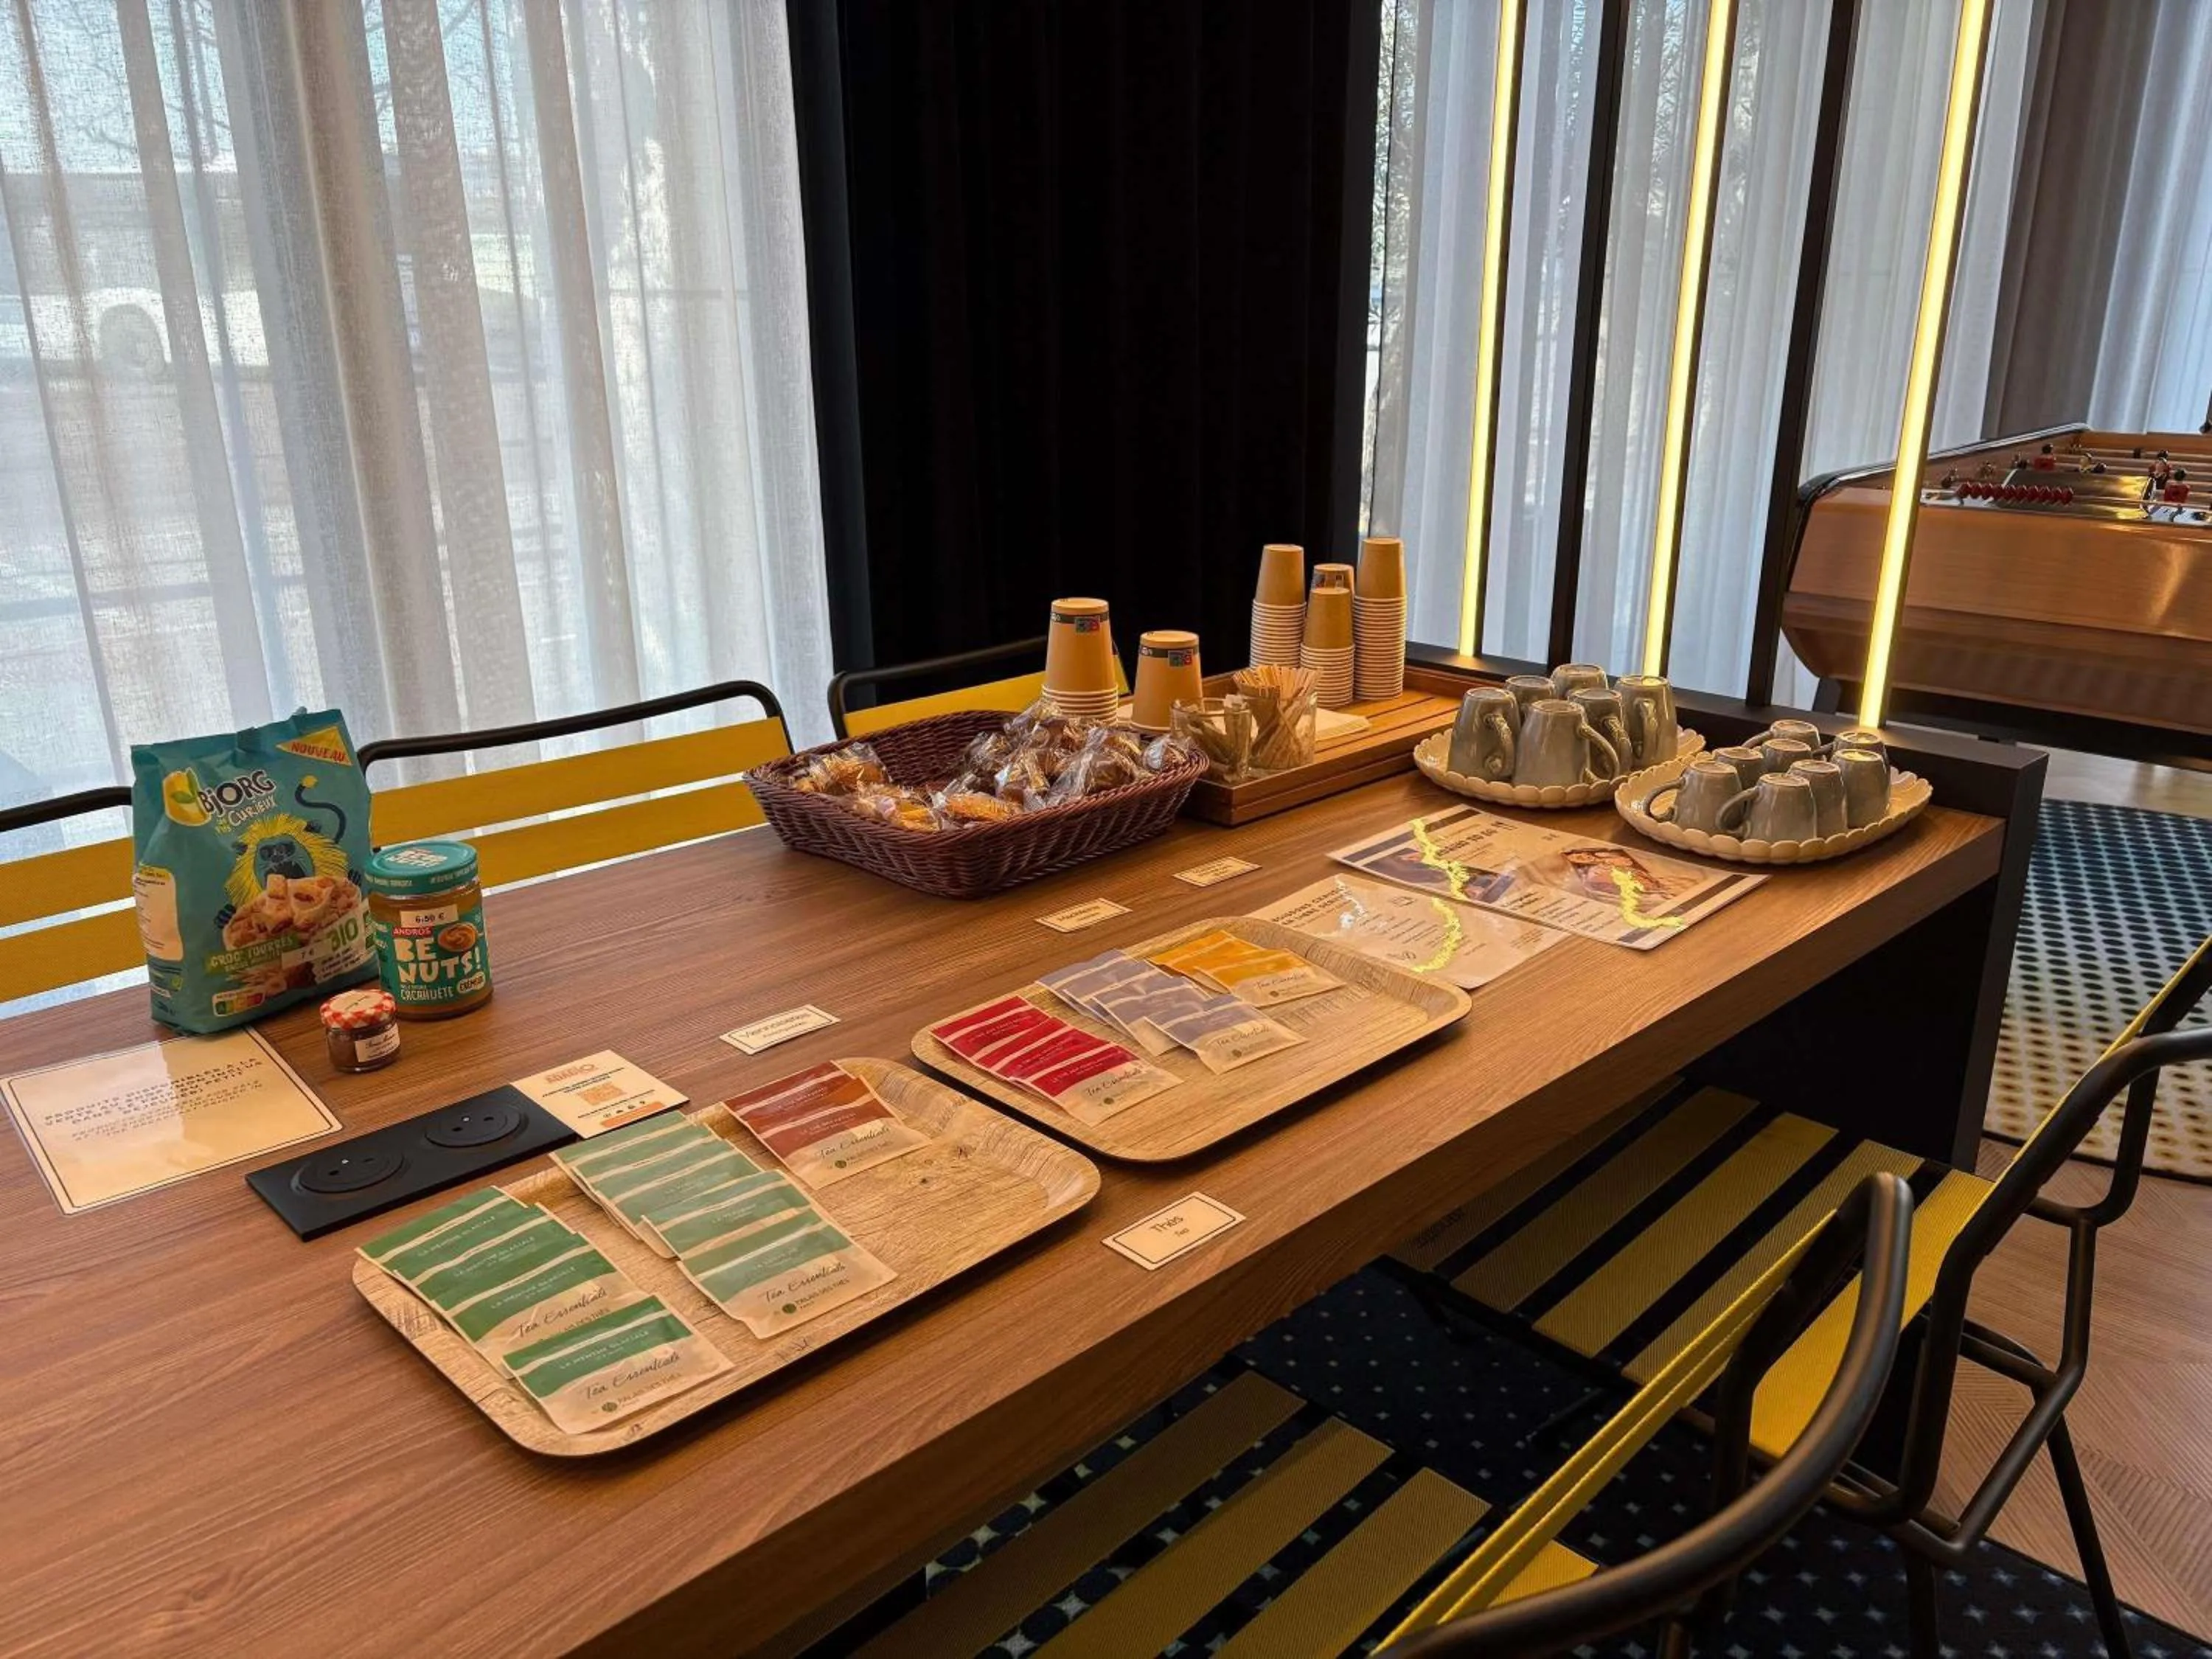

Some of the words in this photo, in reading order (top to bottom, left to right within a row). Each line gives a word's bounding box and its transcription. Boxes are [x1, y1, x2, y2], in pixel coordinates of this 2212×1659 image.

[291, 741, 345, 762] NOUVEAU
[393, 927, 431, 936] ANDROS
[394, 937, 437, 962] BE
[397, 947, 481, 984] NUTS!
[1150, 1217, 1183, 1232] Thés
[765, 1290, 785, 1303] Tea
[518, 1322, 538, 1338] Tea
[586, 1384, 609, 1400] Tea
[613, 1352, 680, 1388] Essentials
